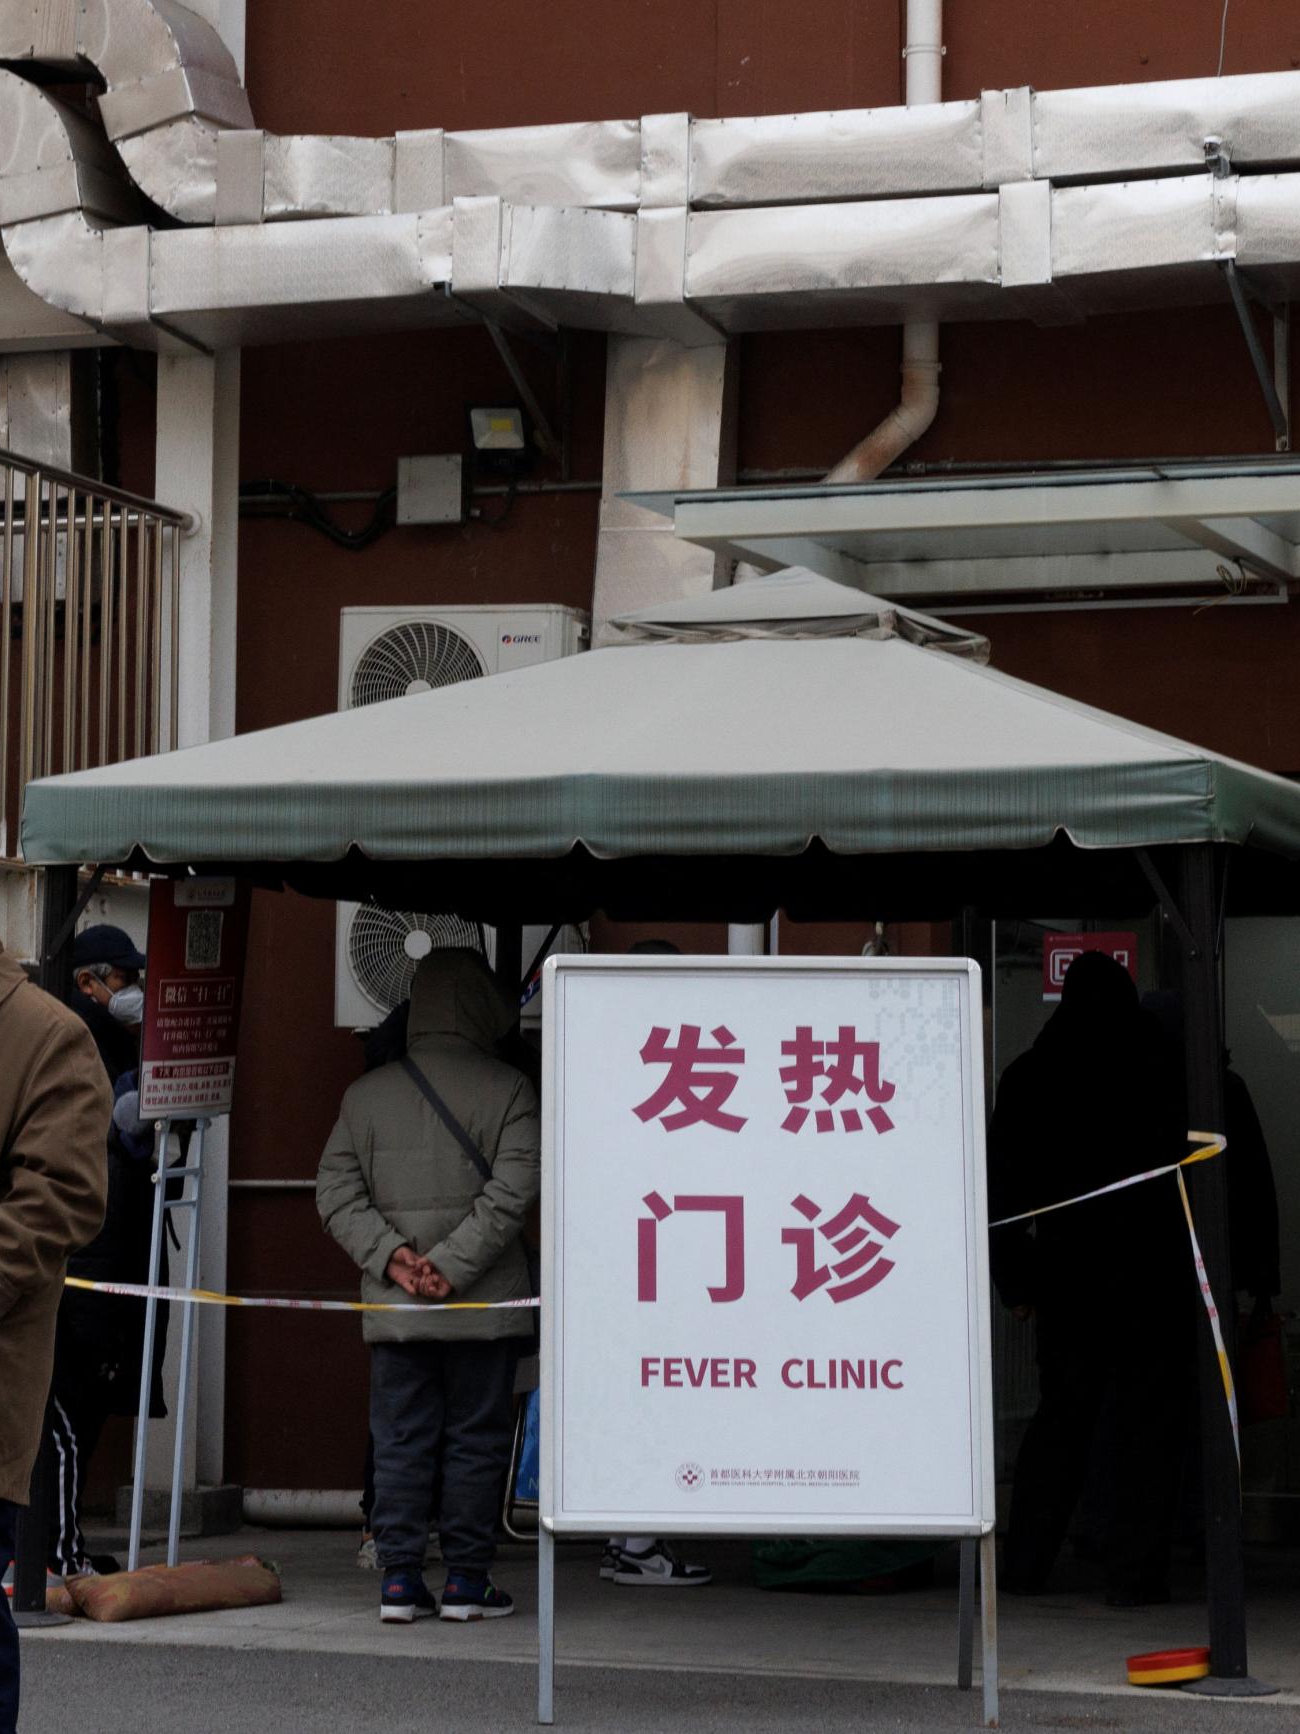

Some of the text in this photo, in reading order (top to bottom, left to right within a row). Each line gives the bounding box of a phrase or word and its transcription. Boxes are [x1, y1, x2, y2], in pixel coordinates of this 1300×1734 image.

[513, 634, 540, 644] GREE
[632, 1023, 897, 1134] 发热
[637, 1190, 901, 1304] 门诊
[640, 1357, 905, 1390] FEVER CLINIC
[710, 1468, 860, 1481] 首都医科大学附属北京朝阳医院
